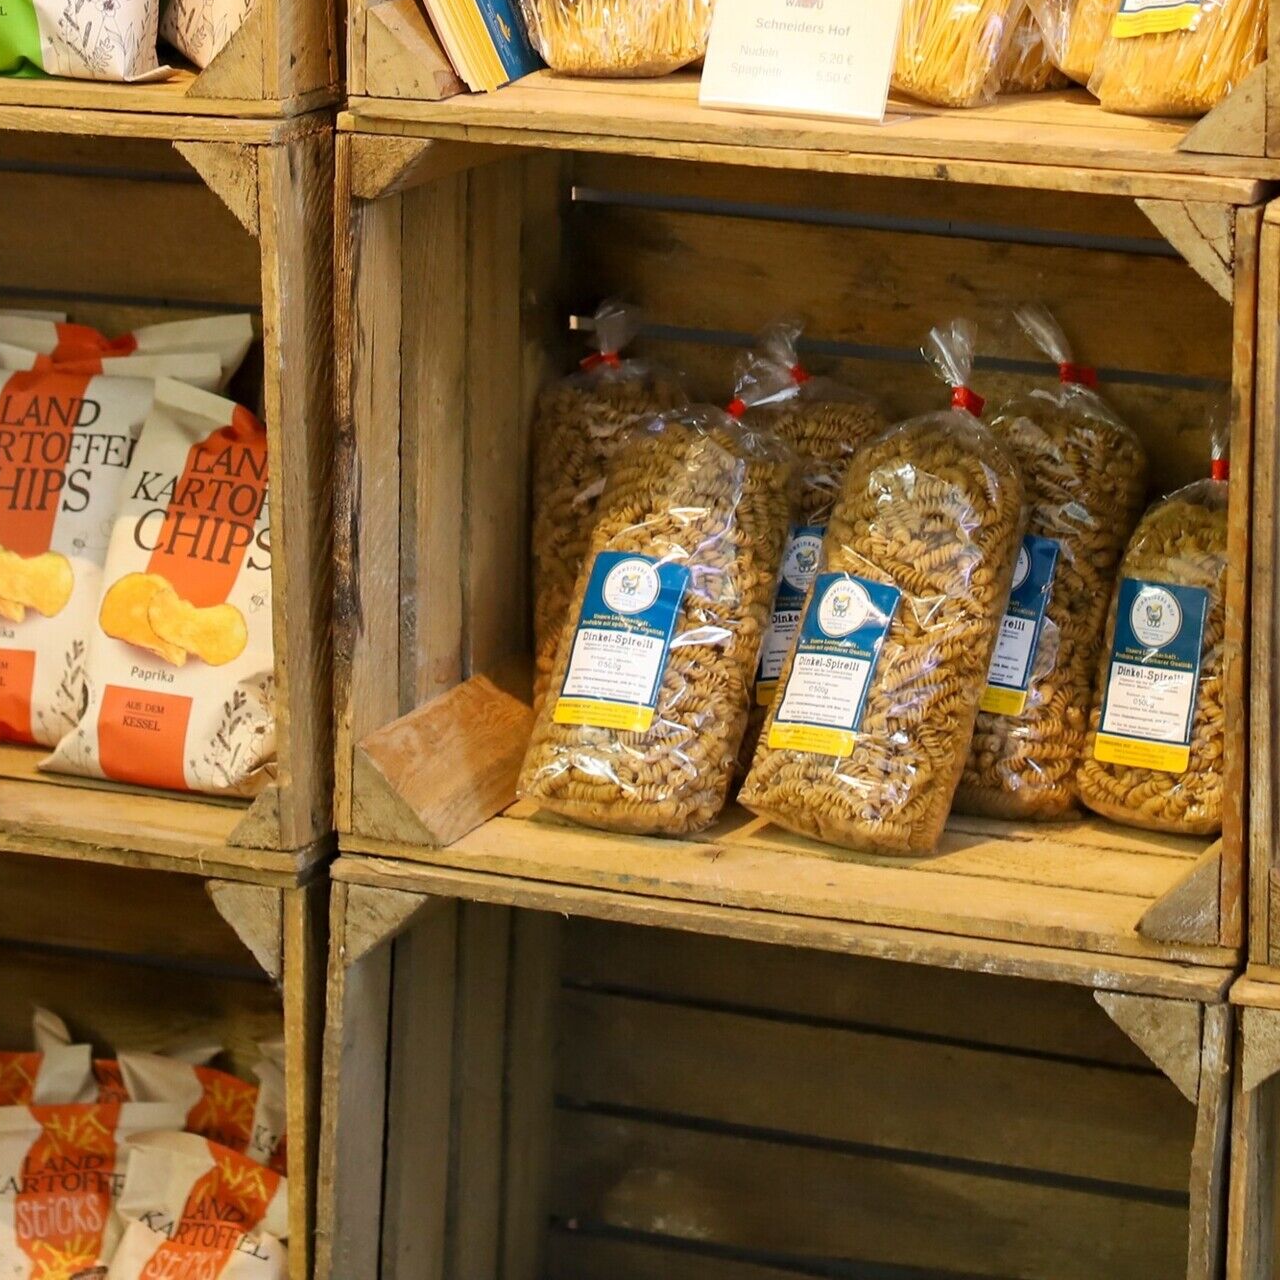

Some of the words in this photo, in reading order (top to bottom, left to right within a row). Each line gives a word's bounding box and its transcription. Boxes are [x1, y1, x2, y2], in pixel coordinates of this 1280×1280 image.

[756, 17, 825, 35] Schneiders
[828, 24, 851, 36] Hof
[739, 45, 779, 58] Nudeln
[847, 55, 854, 66] €
[191, 444, 268, 482] LAN
[583, 632, 654, 650] Dinkel-Spirelli
[798, 656, 860, 671] Dinkel-Spirelli
[130, 666, 175, 684] Paprika
[125, 700, 142, 710] AUS
[145, 703, 165, 714] DEM
[122, 715, 161, 732] KESSEL
[21, 1155, 105, 1175] LAND
[185, 1196, 246, 1221] LAND
[139, 1210, 269, 1261] KARTOFFEL
